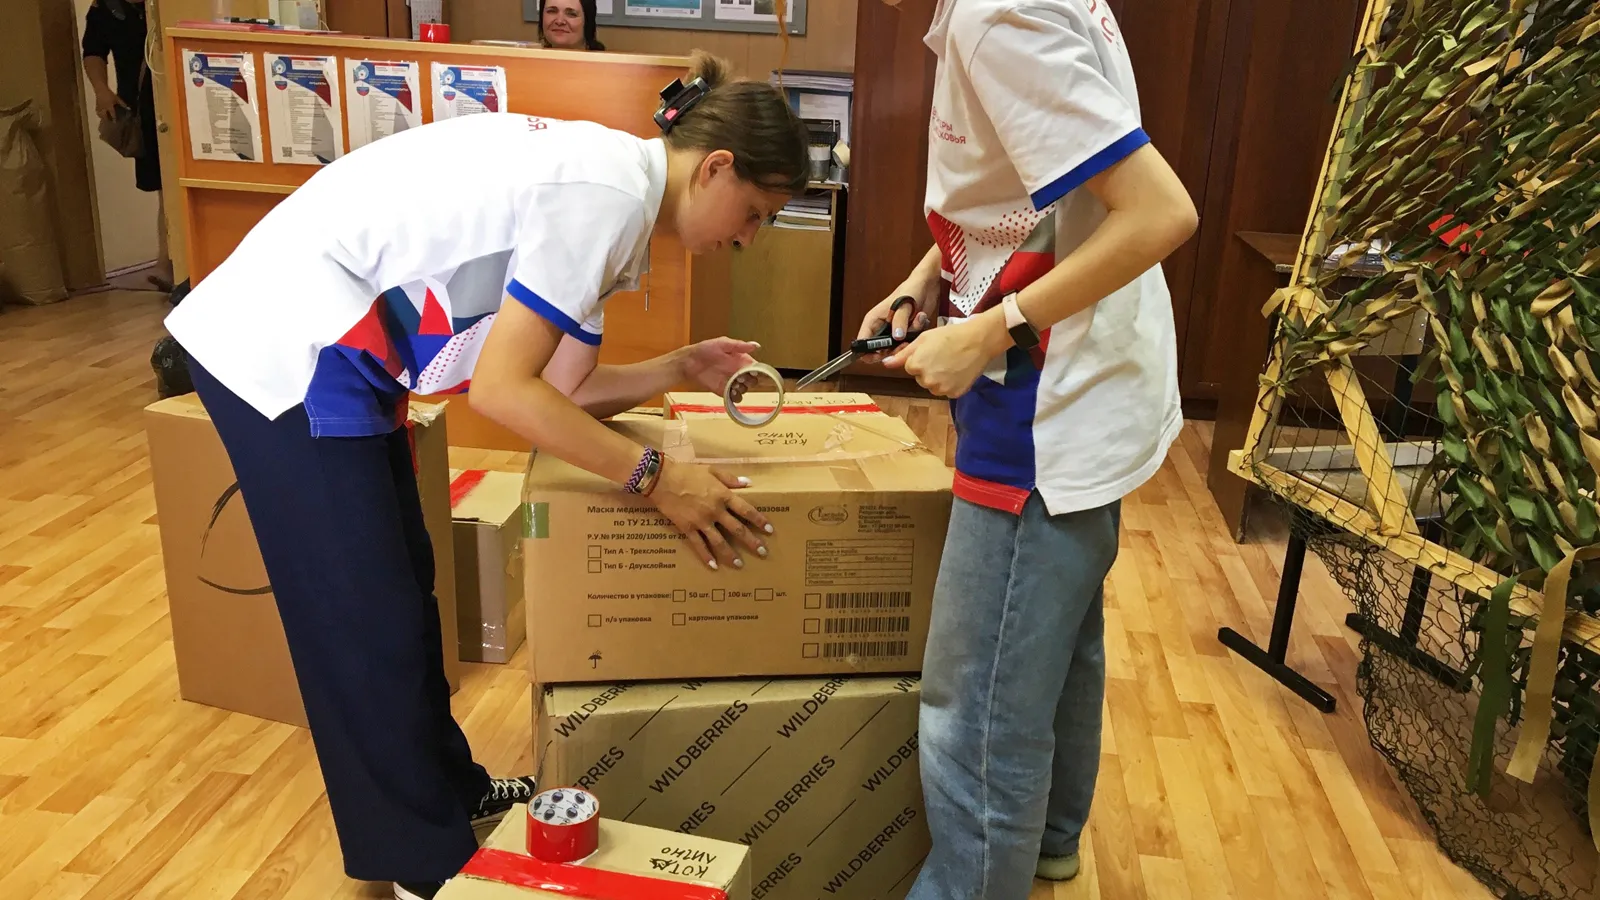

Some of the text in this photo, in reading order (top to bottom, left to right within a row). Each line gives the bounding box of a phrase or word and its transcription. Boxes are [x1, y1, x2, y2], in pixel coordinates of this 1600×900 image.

[627, 518, 639, 526] ТУ
[626, 532, 667, 540] 2020/10095
[630, 547, 676, 555] Трехслойная
[629, 562, 676, 570] Двухслойная
[636, 593, 671, 601] упаковке:
[649, 699, 749, 794] WILDBERRIES
[861, 729, 919, 792] WILDBE
[738, 755, 836, 846] WILDBERRIES
[823, 806, 917, 894] WILDBERRIES
